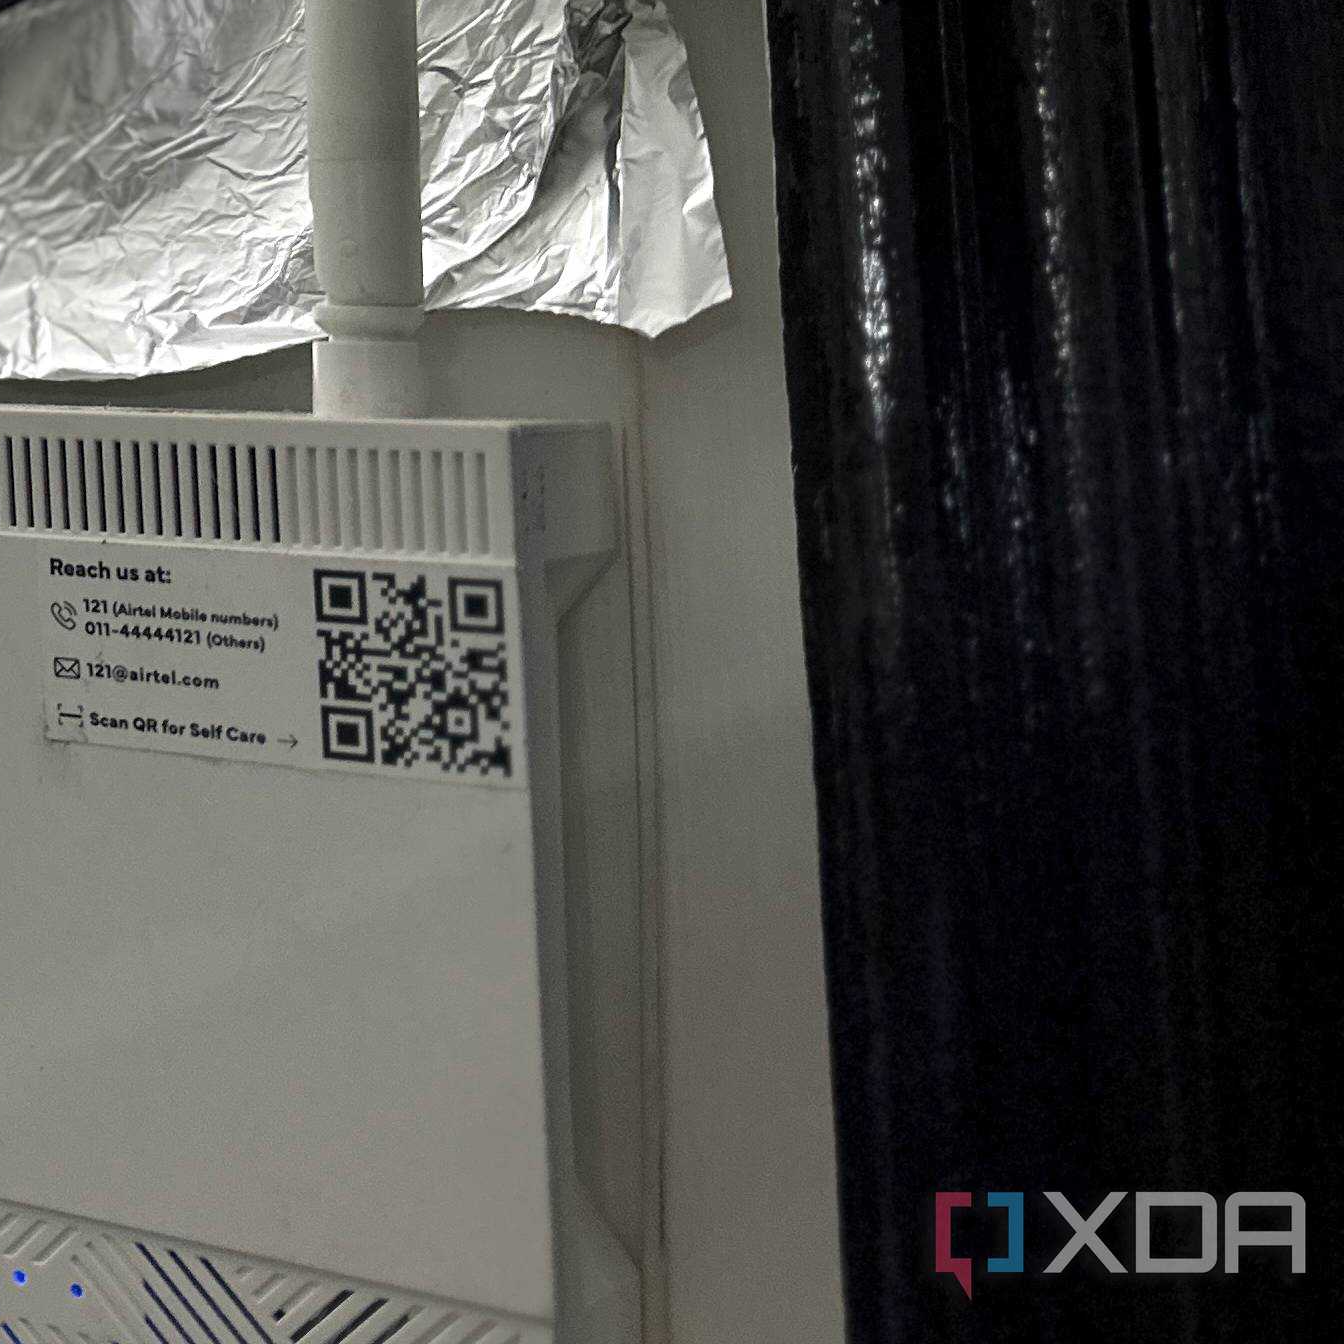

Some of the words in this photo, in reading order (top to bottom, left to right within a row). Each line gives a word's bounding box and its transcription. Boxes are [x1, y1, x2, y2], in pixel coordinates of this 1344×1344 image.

[49, 557, 111, 580] Reach
[116, 565, 139, 581] us
[144, 565, 172, 584] at:
[82, 598, 109, 614] 121
[112, 600, 156, 618] (Airtel
[160, 605, 207, 623] Mobile
[211, 612, 280, 631] numbers)
[84, 621, 201, 645] 011-44444121
[207, 630, 266, 653] (Others)
[86, 662, 220, 690] 121@airtel.com
[89, 712, 129, 730] Scan
[132, 716, 158, 733] QR
[161, 719, 185, 737] for
[190, 722, 223, 740] Self
[226, 726, 267, 745] Care
